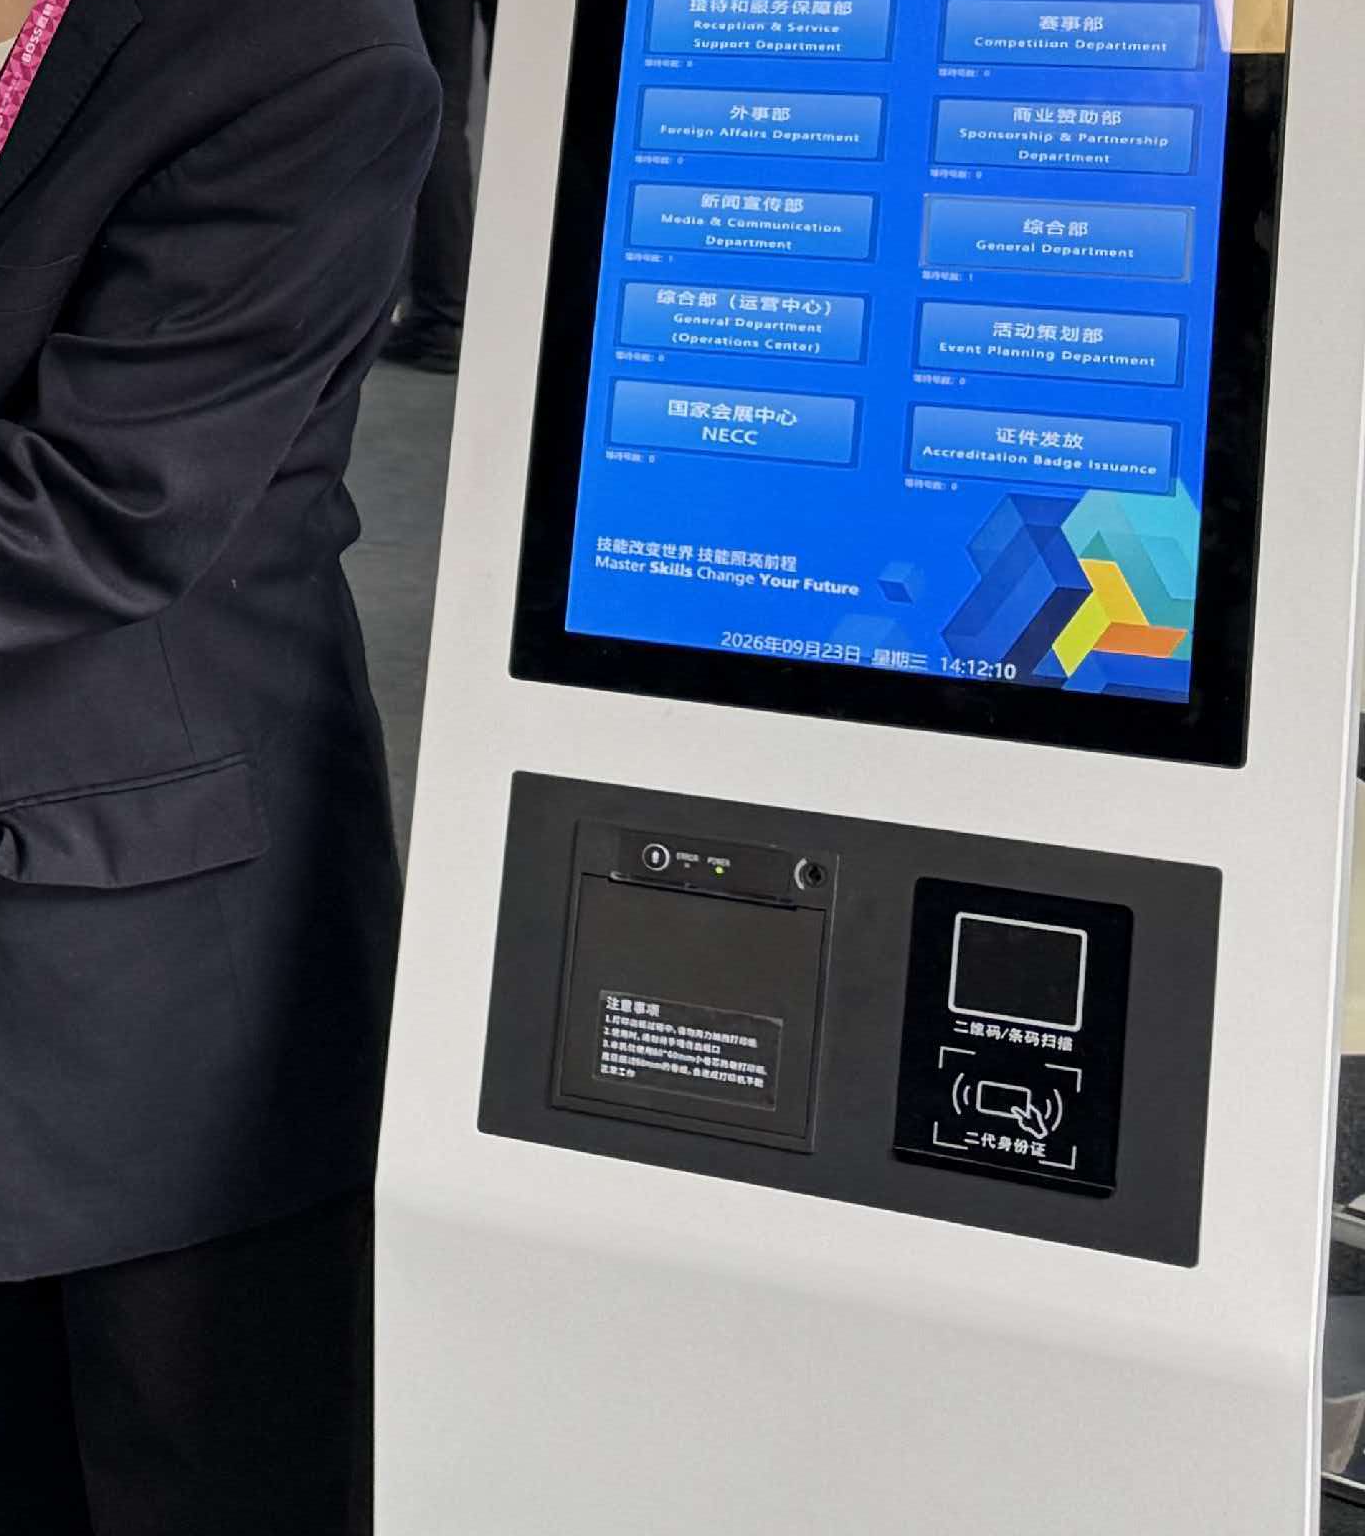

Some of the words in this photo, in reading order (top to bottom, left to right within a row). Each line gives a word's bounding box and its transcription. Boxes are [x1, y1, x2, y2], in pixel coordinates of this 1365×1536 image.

[693, 20, 765, 33] Reception
[770, 21, 782, 32] &
[786, 22, 841, 34] Service
[1039, 15, 1104, 33] 赛事部
[692, 38, 751, 51] Support
[755, 39, 842, 53] Department
[974, 36, 1069, 50] Competition
[1074, 39, 1167, 52] Department
[660, 124, 714, 138] Foreign
[719, 127, 768, 140] Affairs
[772, 130, 860, 144] Department
[959, 128, 1054, 143] Sponsorship
[1060, 131, 1072, 142] &
[1078, 133, 1169, 148] Partnership
[1018, 149, 1110, 164] Department
[700, 192, 805, 214] 新闻宣传部
[661, 213, 705, 226] Media
[727, 218, 842, 233] Communication
[1022, 218, 1089, 237] 综合部
[705, 235, 792, 250] Department
[975, 239, 1036, 253] General
[1041, 243, 1134, 259] Department
[673, 313, 729, 327] General
[734, 317, 822, 334] Department
[992, 321, 1104, 345] 活动策划部
[671, 332, 760, 349] (Operations
[939, 342, 982, 355] Event
[987, 345, 1056, 362] Planning
[1061, 350, 1156, 367] Department
[667, 398, 798, 427] 国家会展中心
[702, 425, 759, 445] NECC
[995, 427, 1085, 451] 证件发放
[922, 445, 1027, 465] Accreditation
[1033, 454, 1082, 470] Badge
[1088, 459, 1158, 476] Issuance
[596, 535, 694, 562] 技能改变世界
[697, 546, 798, 573] 技能照亮前程
[595, 555, 647, 573] Master
[648, 560, 694, 578] Skills
[696, 566, 755, 586] Change
[759, 573, 800, 590] Your
[803, 578, 860, 597] Future
[720, 631, 861, 664] 2026年09月23日
[871, 648, 928, 671] 星期三
[939, 656, 1017, 680] 14:12:10
[953, 1020, 1073, 1052] 二维码/条码扫描
[963, 1131, 1047, 1158] 二代身份证
